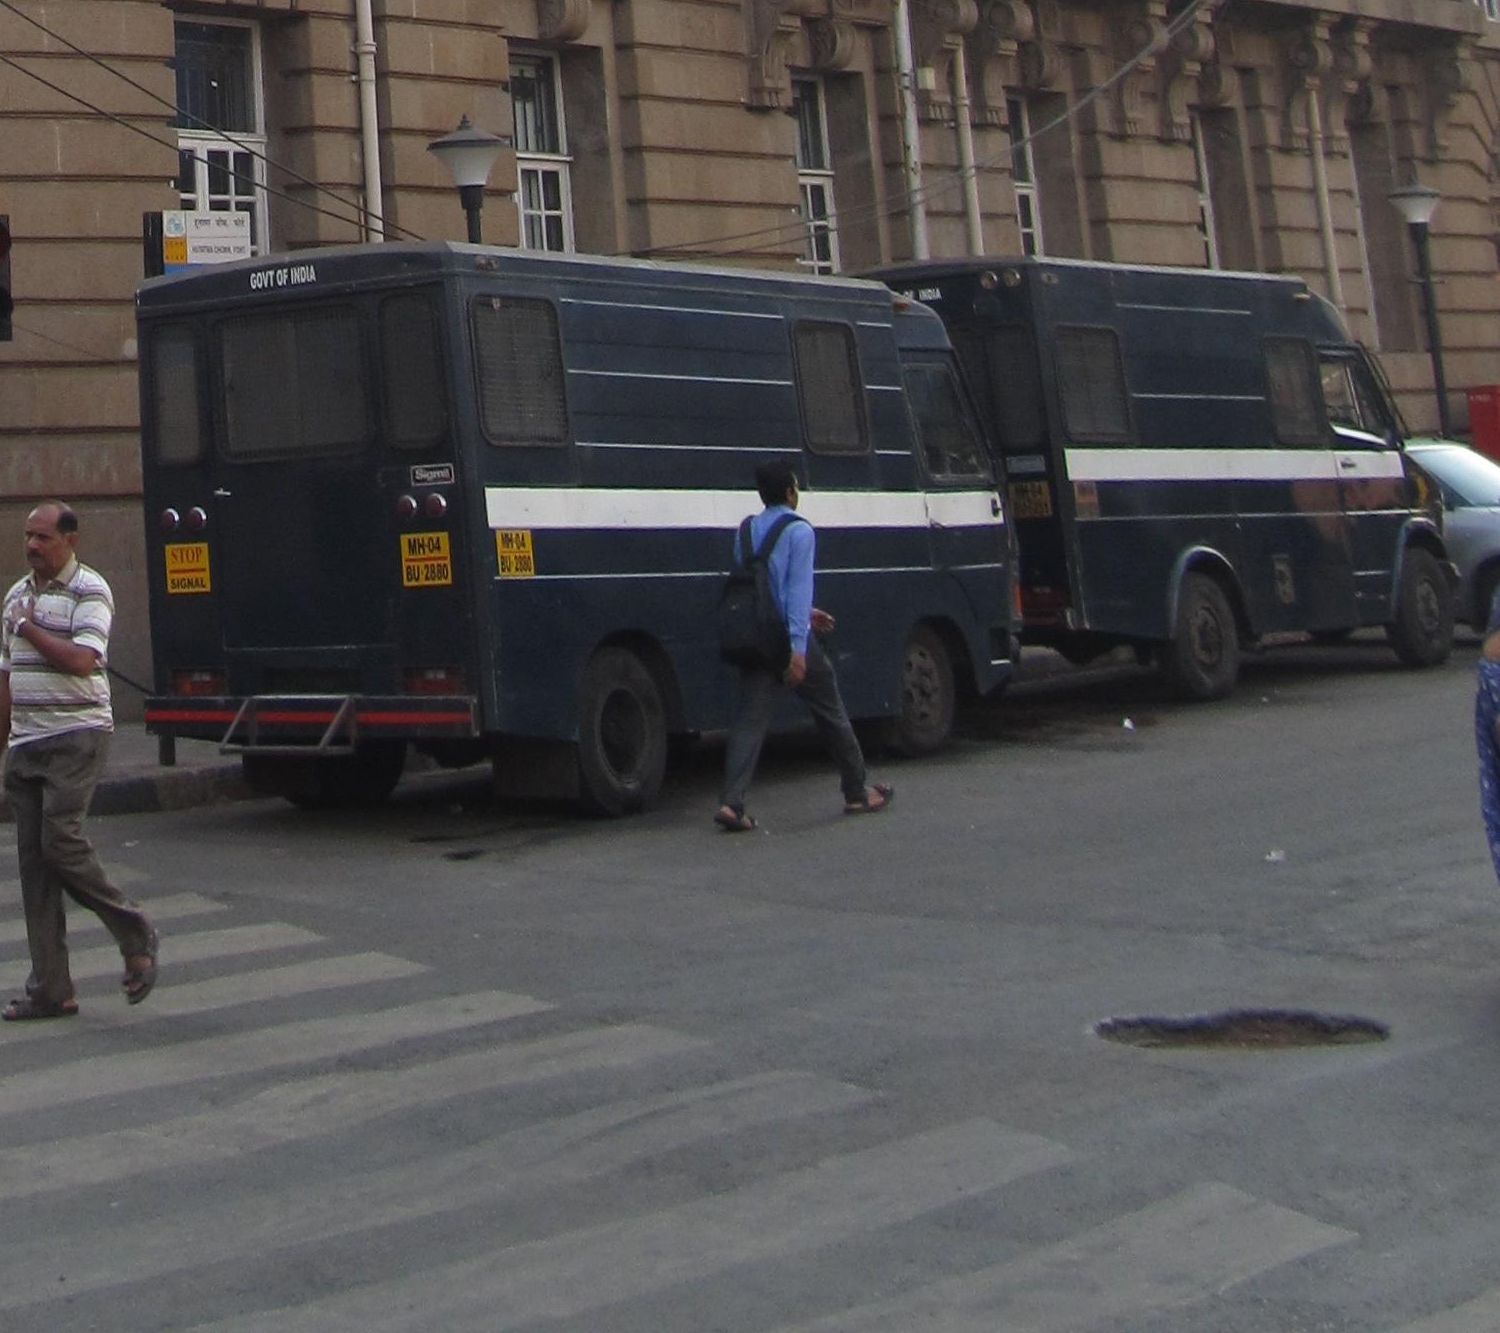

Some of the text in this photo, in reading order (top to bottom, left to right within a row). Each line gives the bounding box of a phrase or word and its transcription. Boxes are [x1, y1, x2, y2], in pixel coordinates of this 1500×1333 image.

[250, 265, 316, 289] GOVT OF INDIA
[171, 547, 202, 564] STOP
[171, 577, 206, 589] SIGNAL
